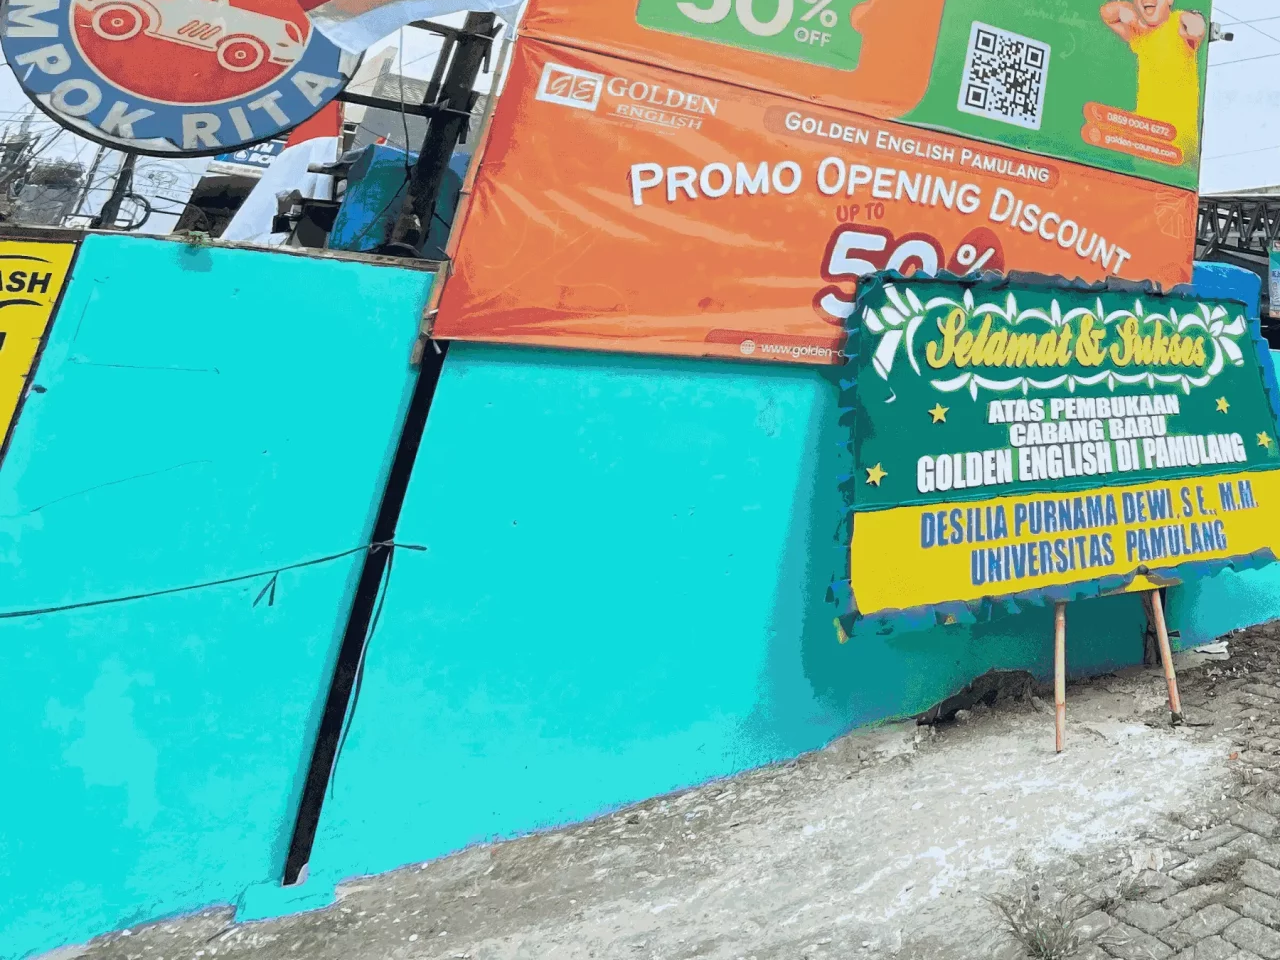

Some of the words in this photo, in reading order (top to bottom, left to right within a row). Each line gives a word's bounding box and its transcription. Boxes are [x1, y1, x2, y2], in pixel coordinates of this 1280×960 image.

[794, 26, 832, 47] OFF
[182, 70, 344, 149] RITA
[607, 76, 720, 116] GOLDEN
[616, 103, 703, 130] ENGLISH
[248, 143, 275, 154] TM
[785, 111, 870, 146] GOLDEN
[875, 131, 954, 163] ENGLISH
[960, 149, 1051, 184] PAMULANG
[631, 160, 802, 207] PROMO
[817, 156, 980, 214] OPENING
[989, 187, 1132, 276] DISCOUNT
[836, 203, 860, 223] UP
[865, 202, 885, 221] TO
[0, 271, 52, 293] SH
[761, 343, 845, 358] www.golden-c
[926, 307, 1074, 368] Selamat
[1075, 312, 1107, 367] &
[1110, 316, 1206, 368] Sukses
[988, 398, 1045, 424] ATAS
[1050, 395, 1180, 419] PEMBUKAAN
[1010, 419, 1104, 447] CABANG
[1109, 415, 1167, 439] BARU
[917, 450, 1013, 493] GOLDEN
[1017, 442, 1113, 481] ENGLISH
[1117, 439, 1140, 473] DI
[1143, 432, 1247, 468] PAMULANG
[920, 501, 1007, 549] DESILIA
[1014, 493, 1118, 536] PURNAMA
[1218, 480, 1260, 512] M.M.
[970, 533, 1116, 586] UNIVERSITAS
[1126, 520, 1227, 562] PAMULANG
